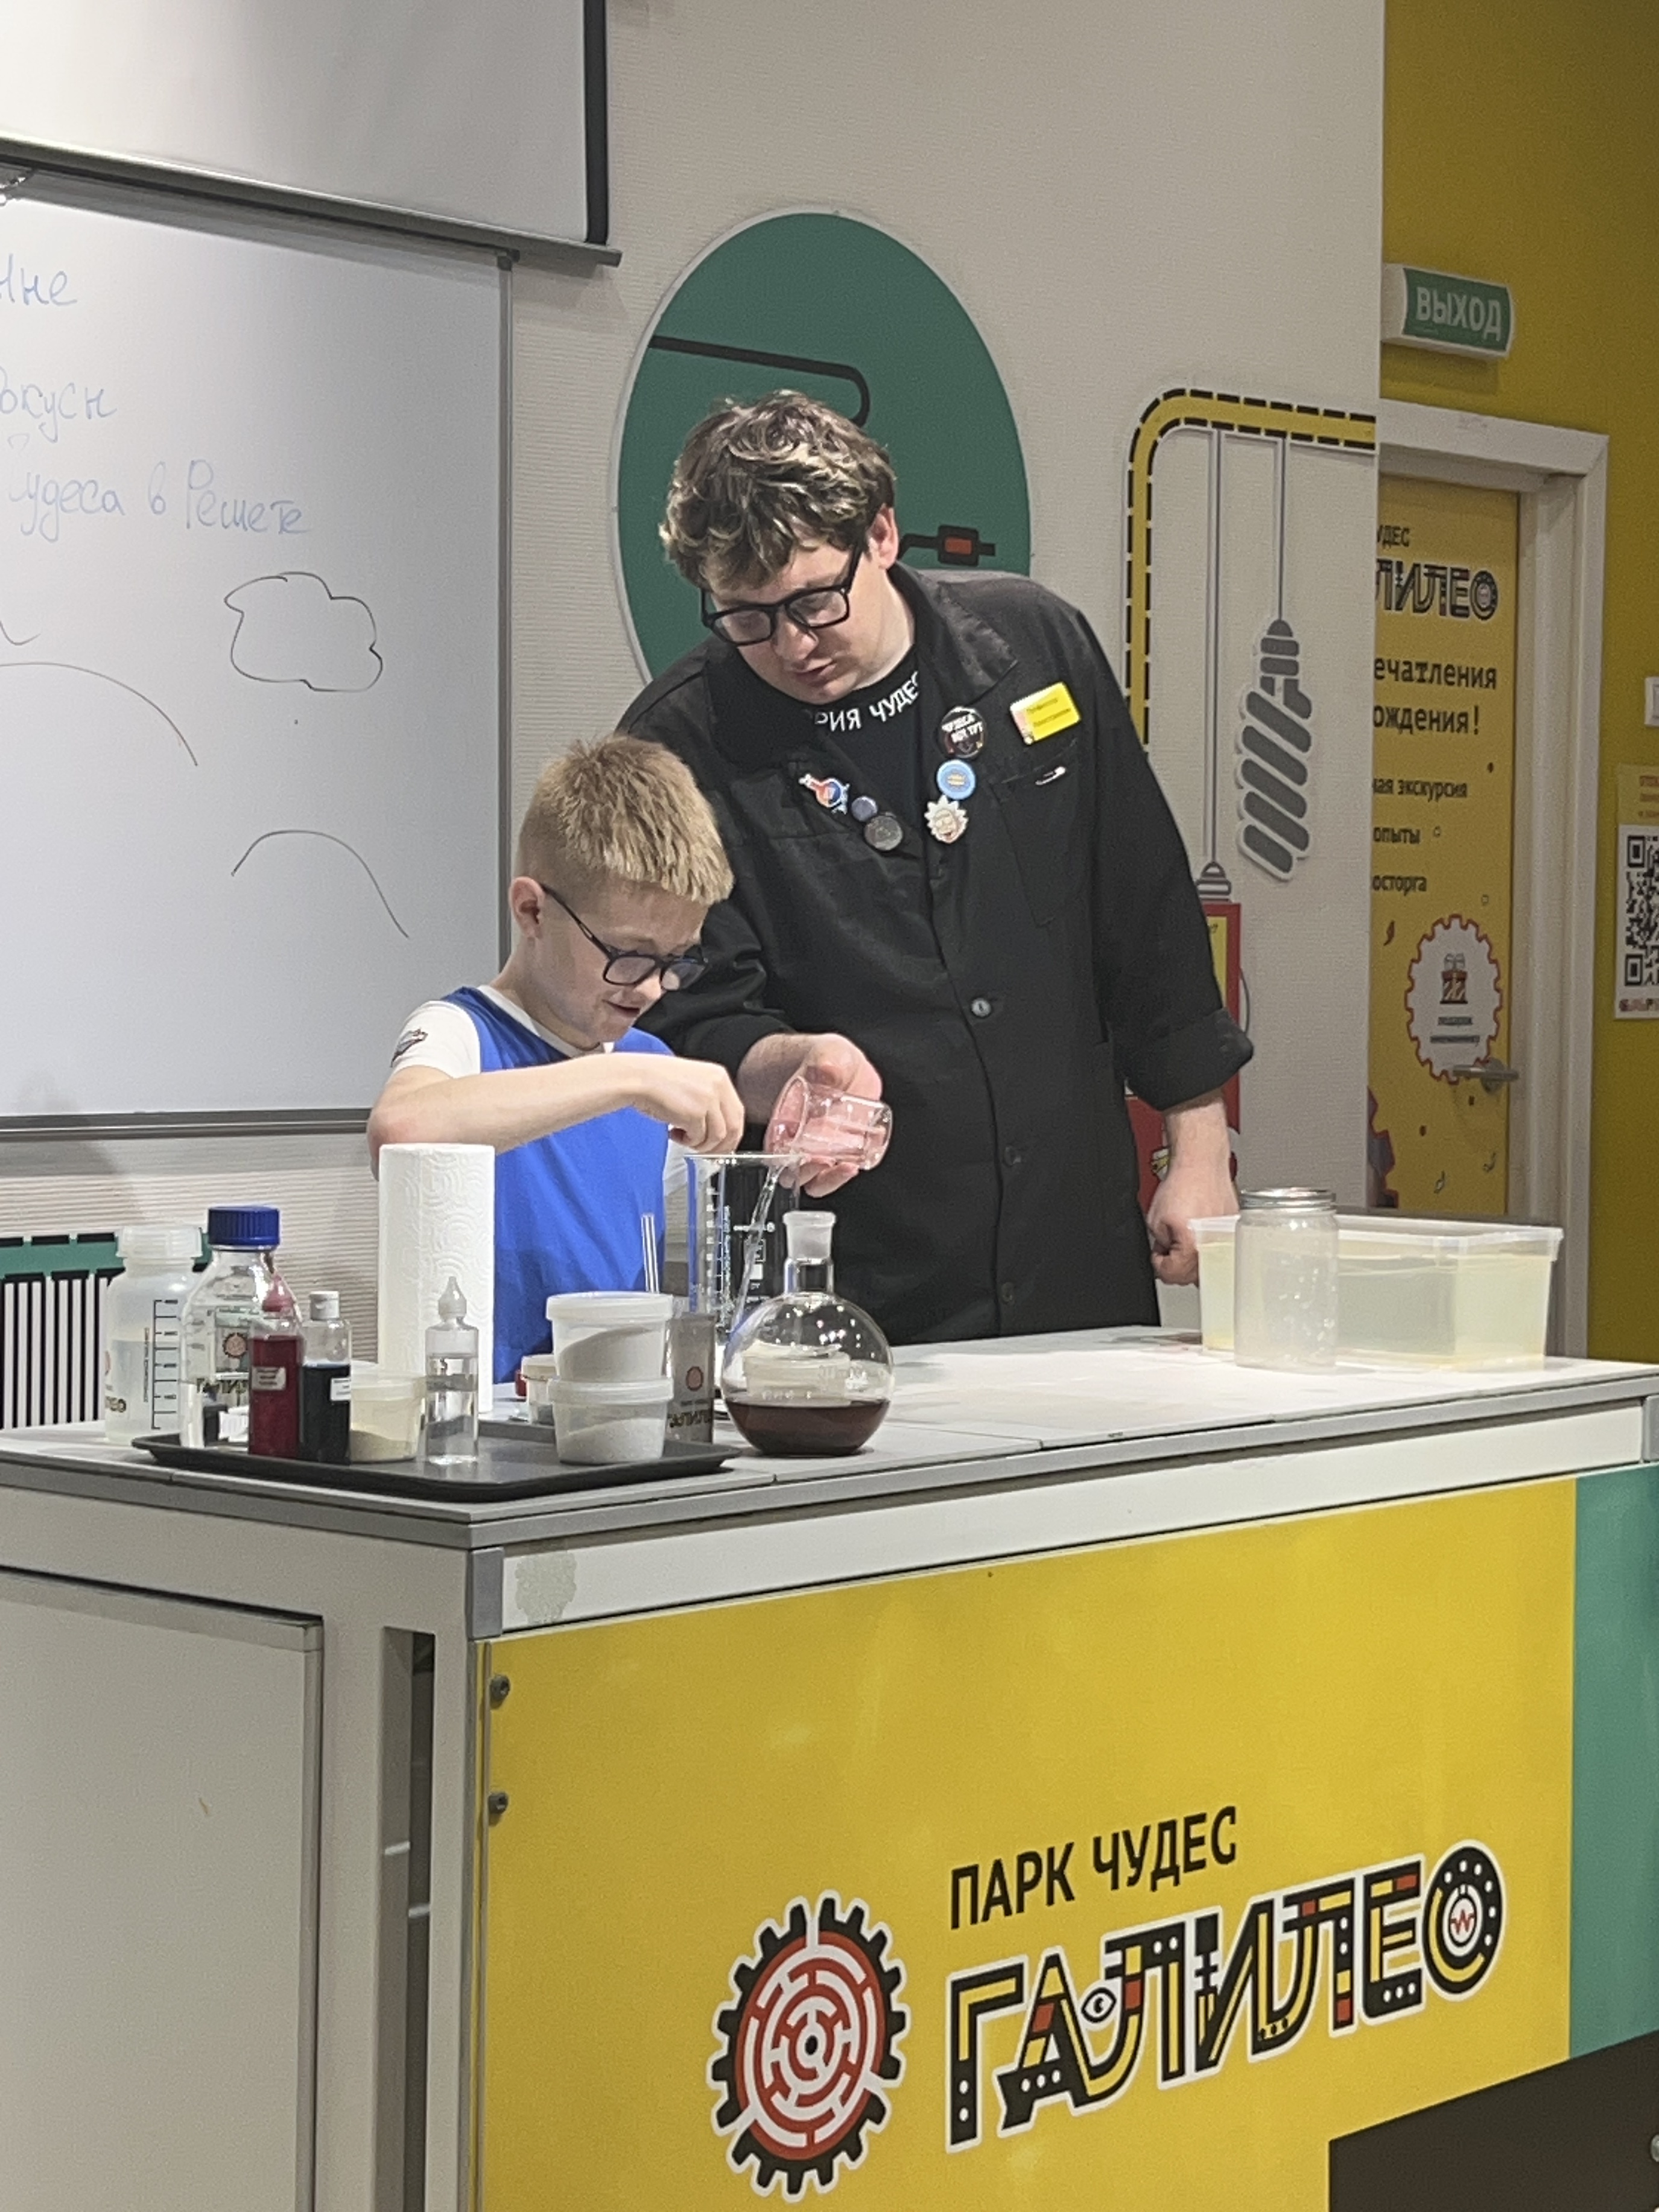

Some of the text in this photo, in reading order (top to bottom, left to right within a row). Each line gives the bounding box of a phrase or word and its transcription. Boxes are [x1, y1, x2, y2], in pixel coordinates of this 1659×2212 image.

[1416, 286, 1502, 342] ВЫХОД
[148, 460, 167, 515] в
[1374, 657, 1497, 690] ечатления
[1373, 705, 1480, 735] ождения!
[1397, 779, 1468, 803] экскурсия
[1373, 827, 1421, 845] опыты
[1372, 875, 1427, 897] осторга
[950, 1805, 1237, 1930] ПАРК ЧУДЕС
[948, 1843, 1505, 2148] ГАЛИЛЕО
